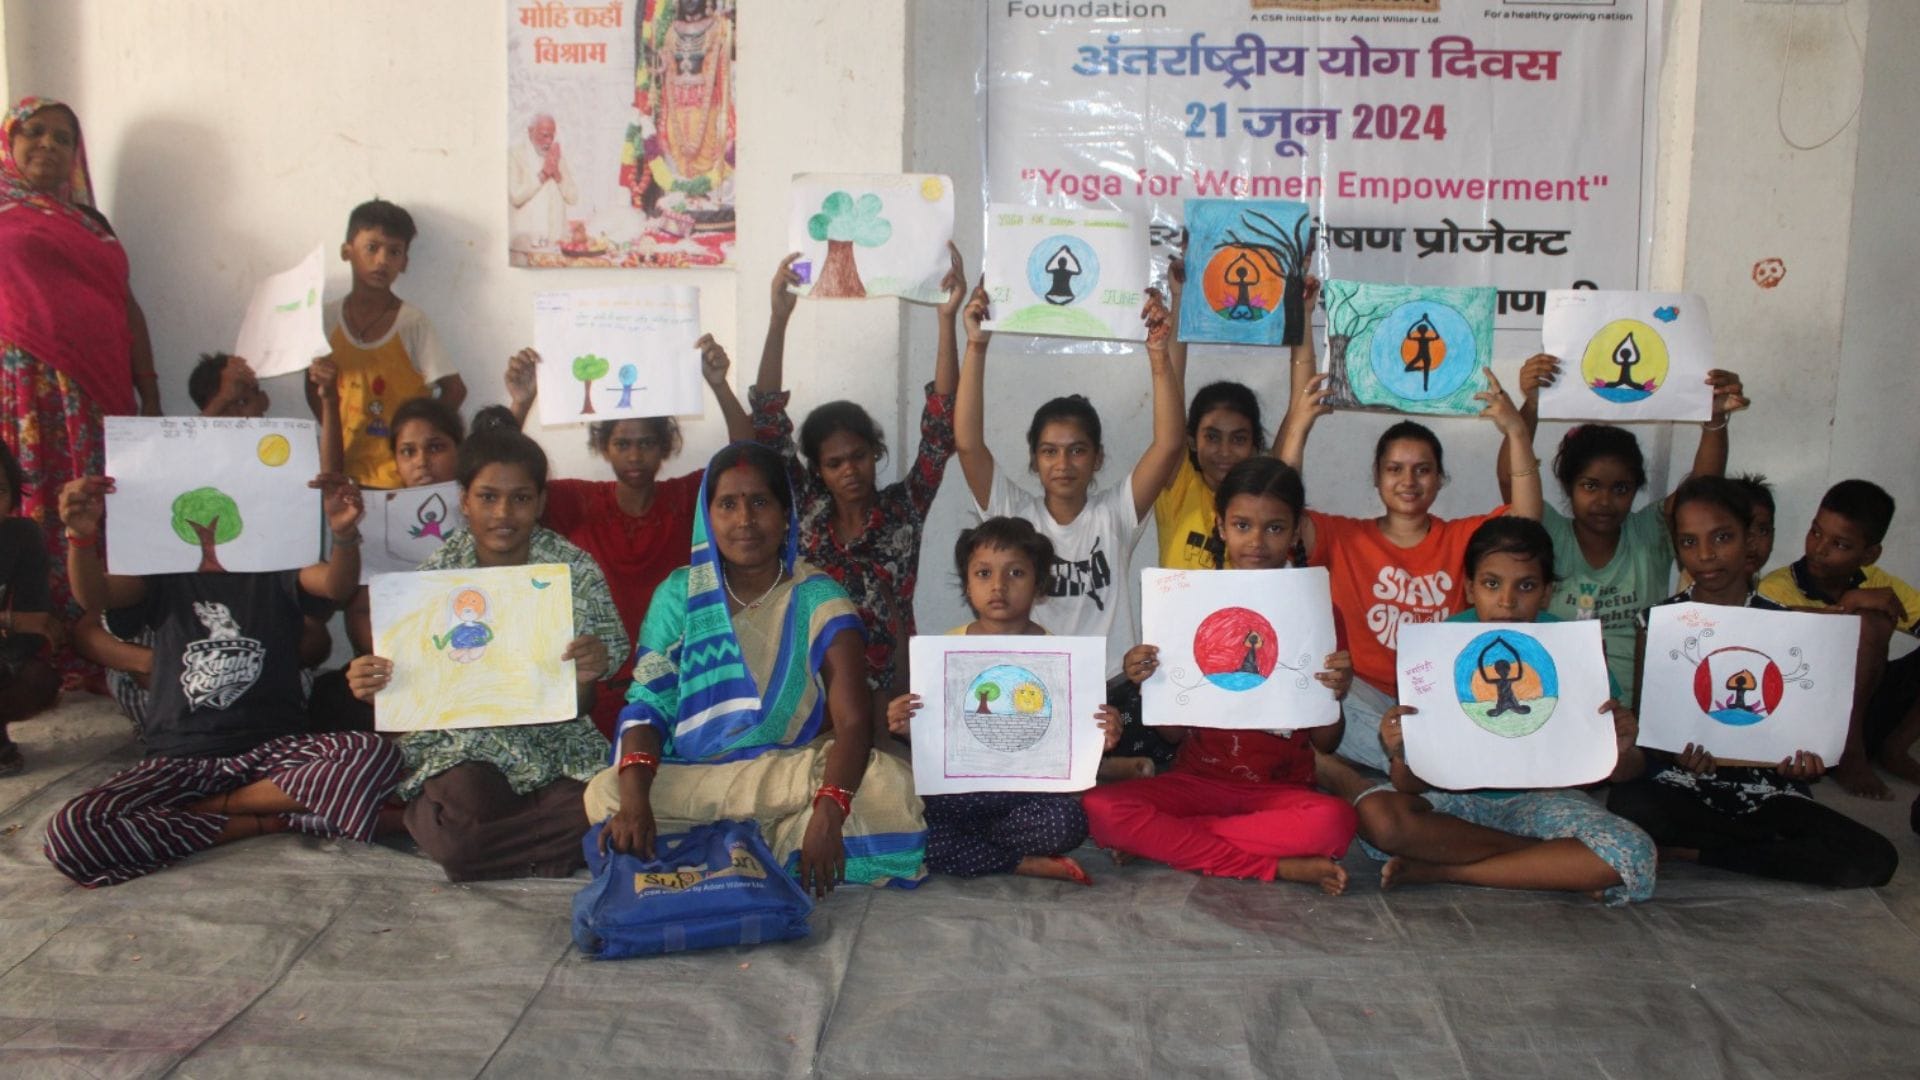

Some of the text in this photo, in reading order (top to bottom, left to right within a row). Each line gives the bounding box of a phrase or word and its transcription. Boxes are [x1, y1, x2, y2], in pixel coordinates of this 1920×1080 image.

[519, 0, 569, 28] मोहि
[1008, 0, 1167, 18] Foundation
[1335, 15, 1347, 24] by
[1351, 15, 1379, 23] Adani
[1383, 15, 1418, 24] Wilmar
[1484, 10, 1501, 18] For
[1511, 11, 1550, 20] healthy
[1552, 12, 1596, 21] growing
[1598, 12, 1633, 20] nation
[1072, 33, 1562, 90] अंतर्राष्ट्रीय योग दिवस
[1184, 102, 1446, 157] 21 जून 2024
[1136, 169, 1182, 196] for
[1194, 170, 1322, 198] Women
[1339, 171, 1607, 204] Empowerment"
[1414, 217, 1571, 258] प्रोजेक्ट
[1373, 566, 1452, 606] STAY
